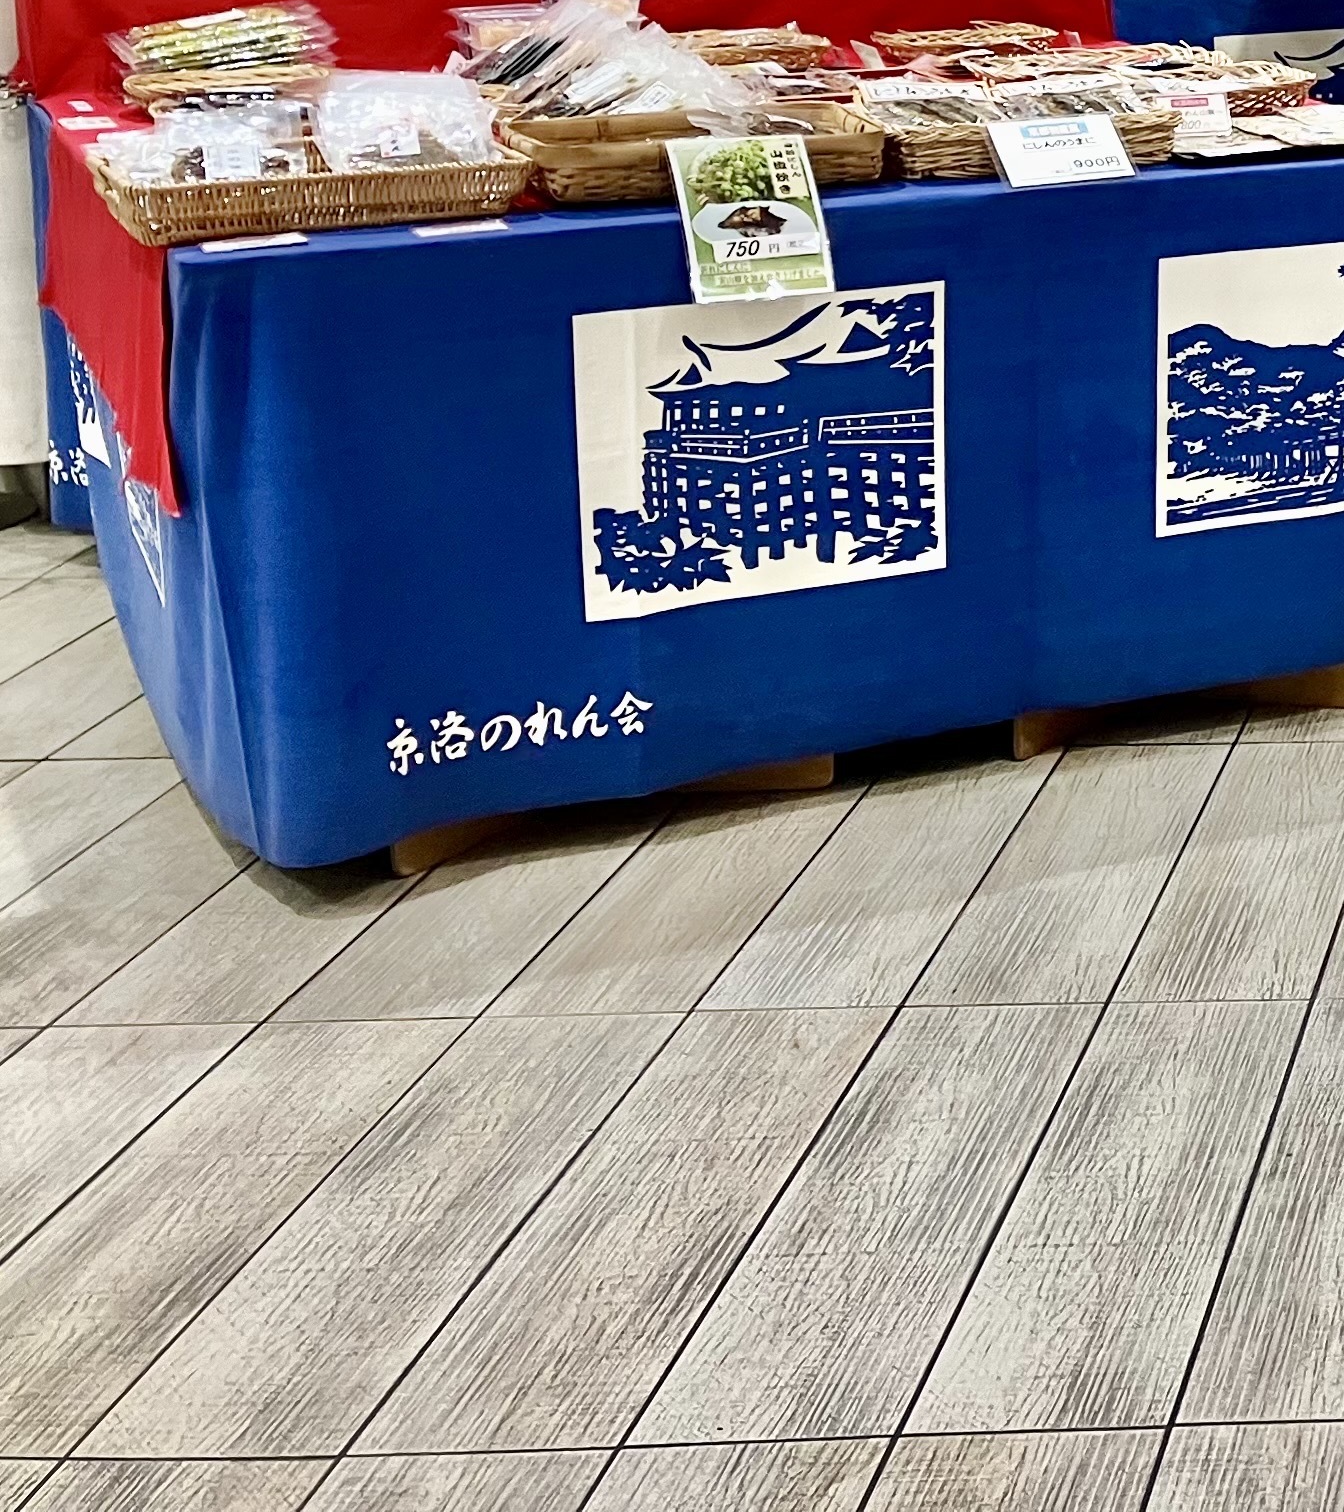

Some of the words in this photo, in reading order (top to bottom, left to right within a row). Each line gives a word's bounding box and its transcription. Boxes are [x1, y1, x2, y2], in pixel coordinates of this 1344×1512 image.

[1072, 155, 1121, 168] 900円
[725, 240, 760, 259] 750
[386, 690, 654, 776] 京洛のれん会
